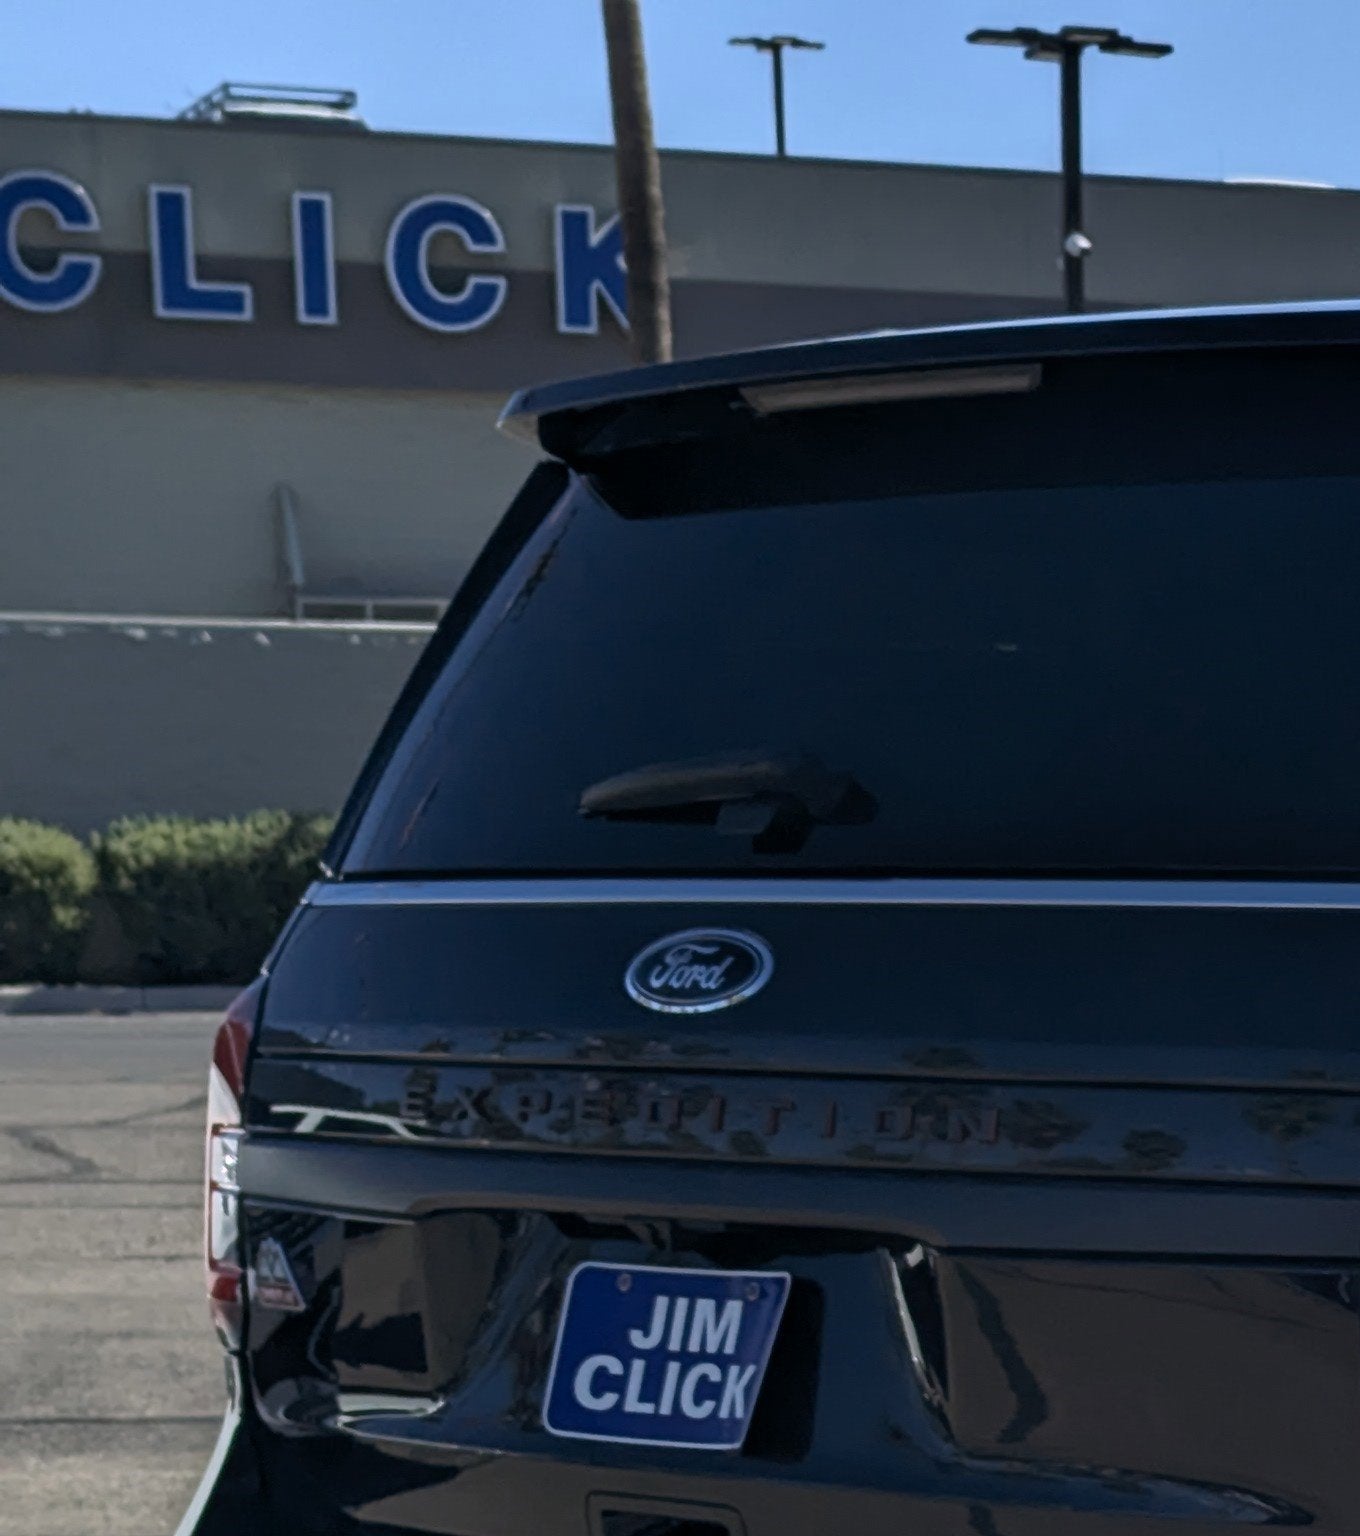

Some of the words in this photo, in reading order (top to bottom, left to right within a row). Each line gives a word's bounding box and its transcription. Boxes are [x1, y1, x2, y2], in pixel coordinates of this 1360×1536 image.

[0, 169, 631, 335] CLICK
[650, 943, 735, 990] Ford
[399, 1078, 1000, 1144] EXPEDITION
[628, 1294, 744, 1355] JIM
[573, 1354, 757, 1420] CLICK
